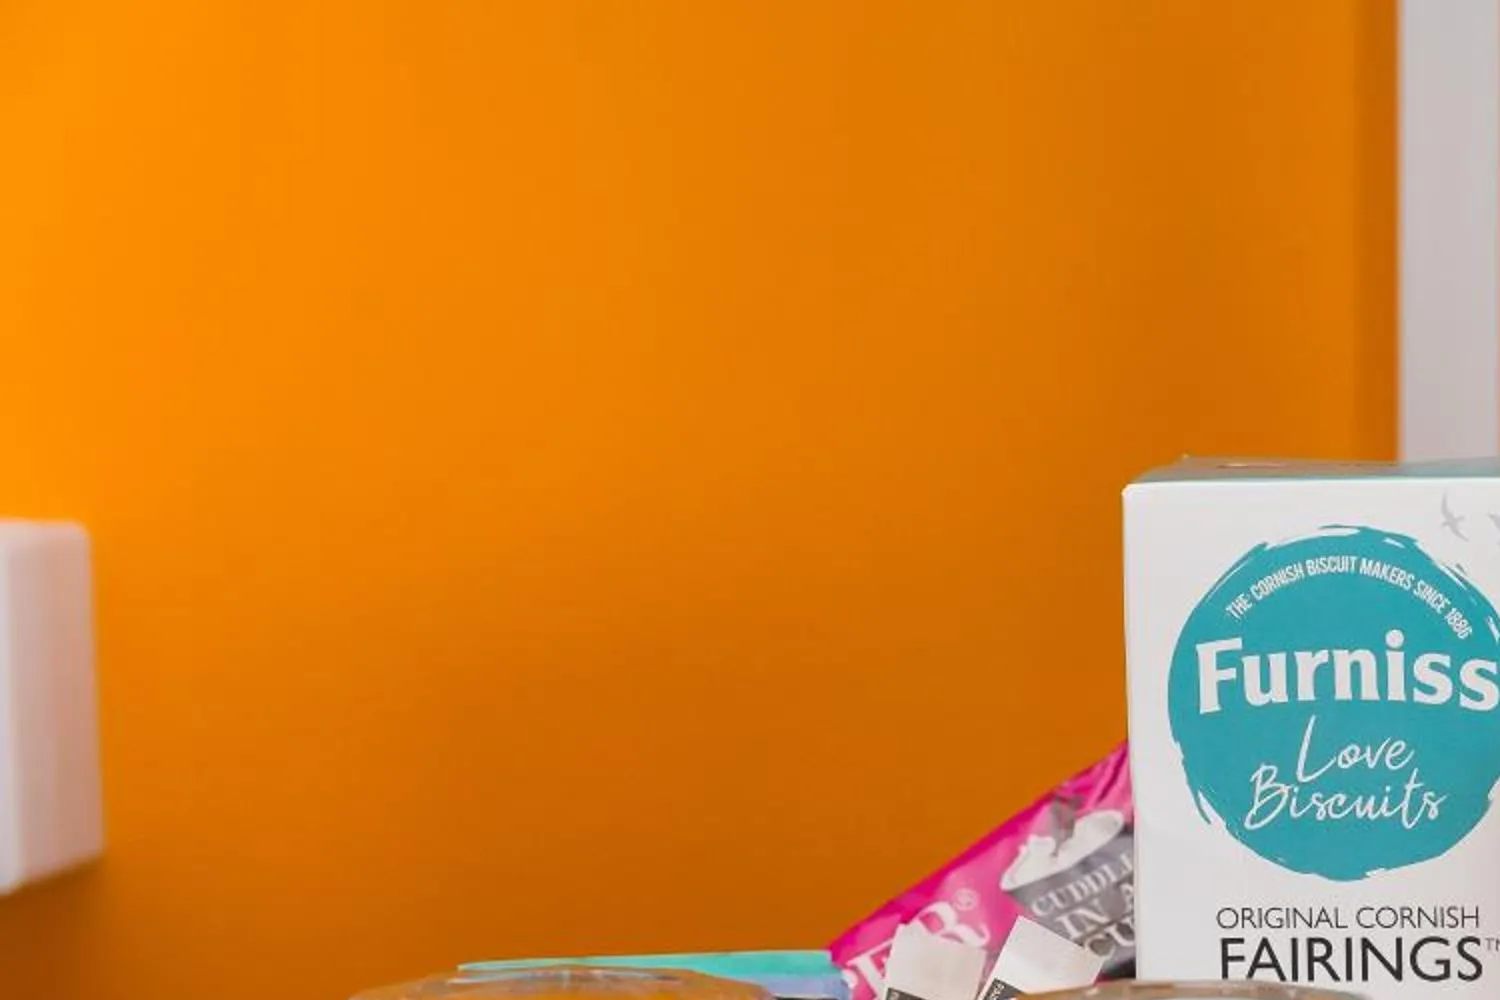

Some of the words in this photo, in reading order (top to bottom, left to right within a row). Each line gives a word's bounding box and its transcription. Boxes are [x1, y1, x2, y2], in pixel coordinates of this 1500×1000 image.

[1226, 593, 1253, 620] THE
[1251, 563, 1305, 601] CORNISH
[1305, 556, 1357, 576] BISCUIT
[1359, 557, 1416, 591] MAKERS
[1412, 579, 1451, 614] SINCE
[1195, 629, 1500, 716] Furniss
[1294, 714, 1414, 782] Love
[1243, 764, 1449, 831] Biscuits
[1055, 897, 1111, 940] IN
[1216, 906, 1348, 929] ORIGINAL
[1355, 905, 1480, 929] CORNISH
